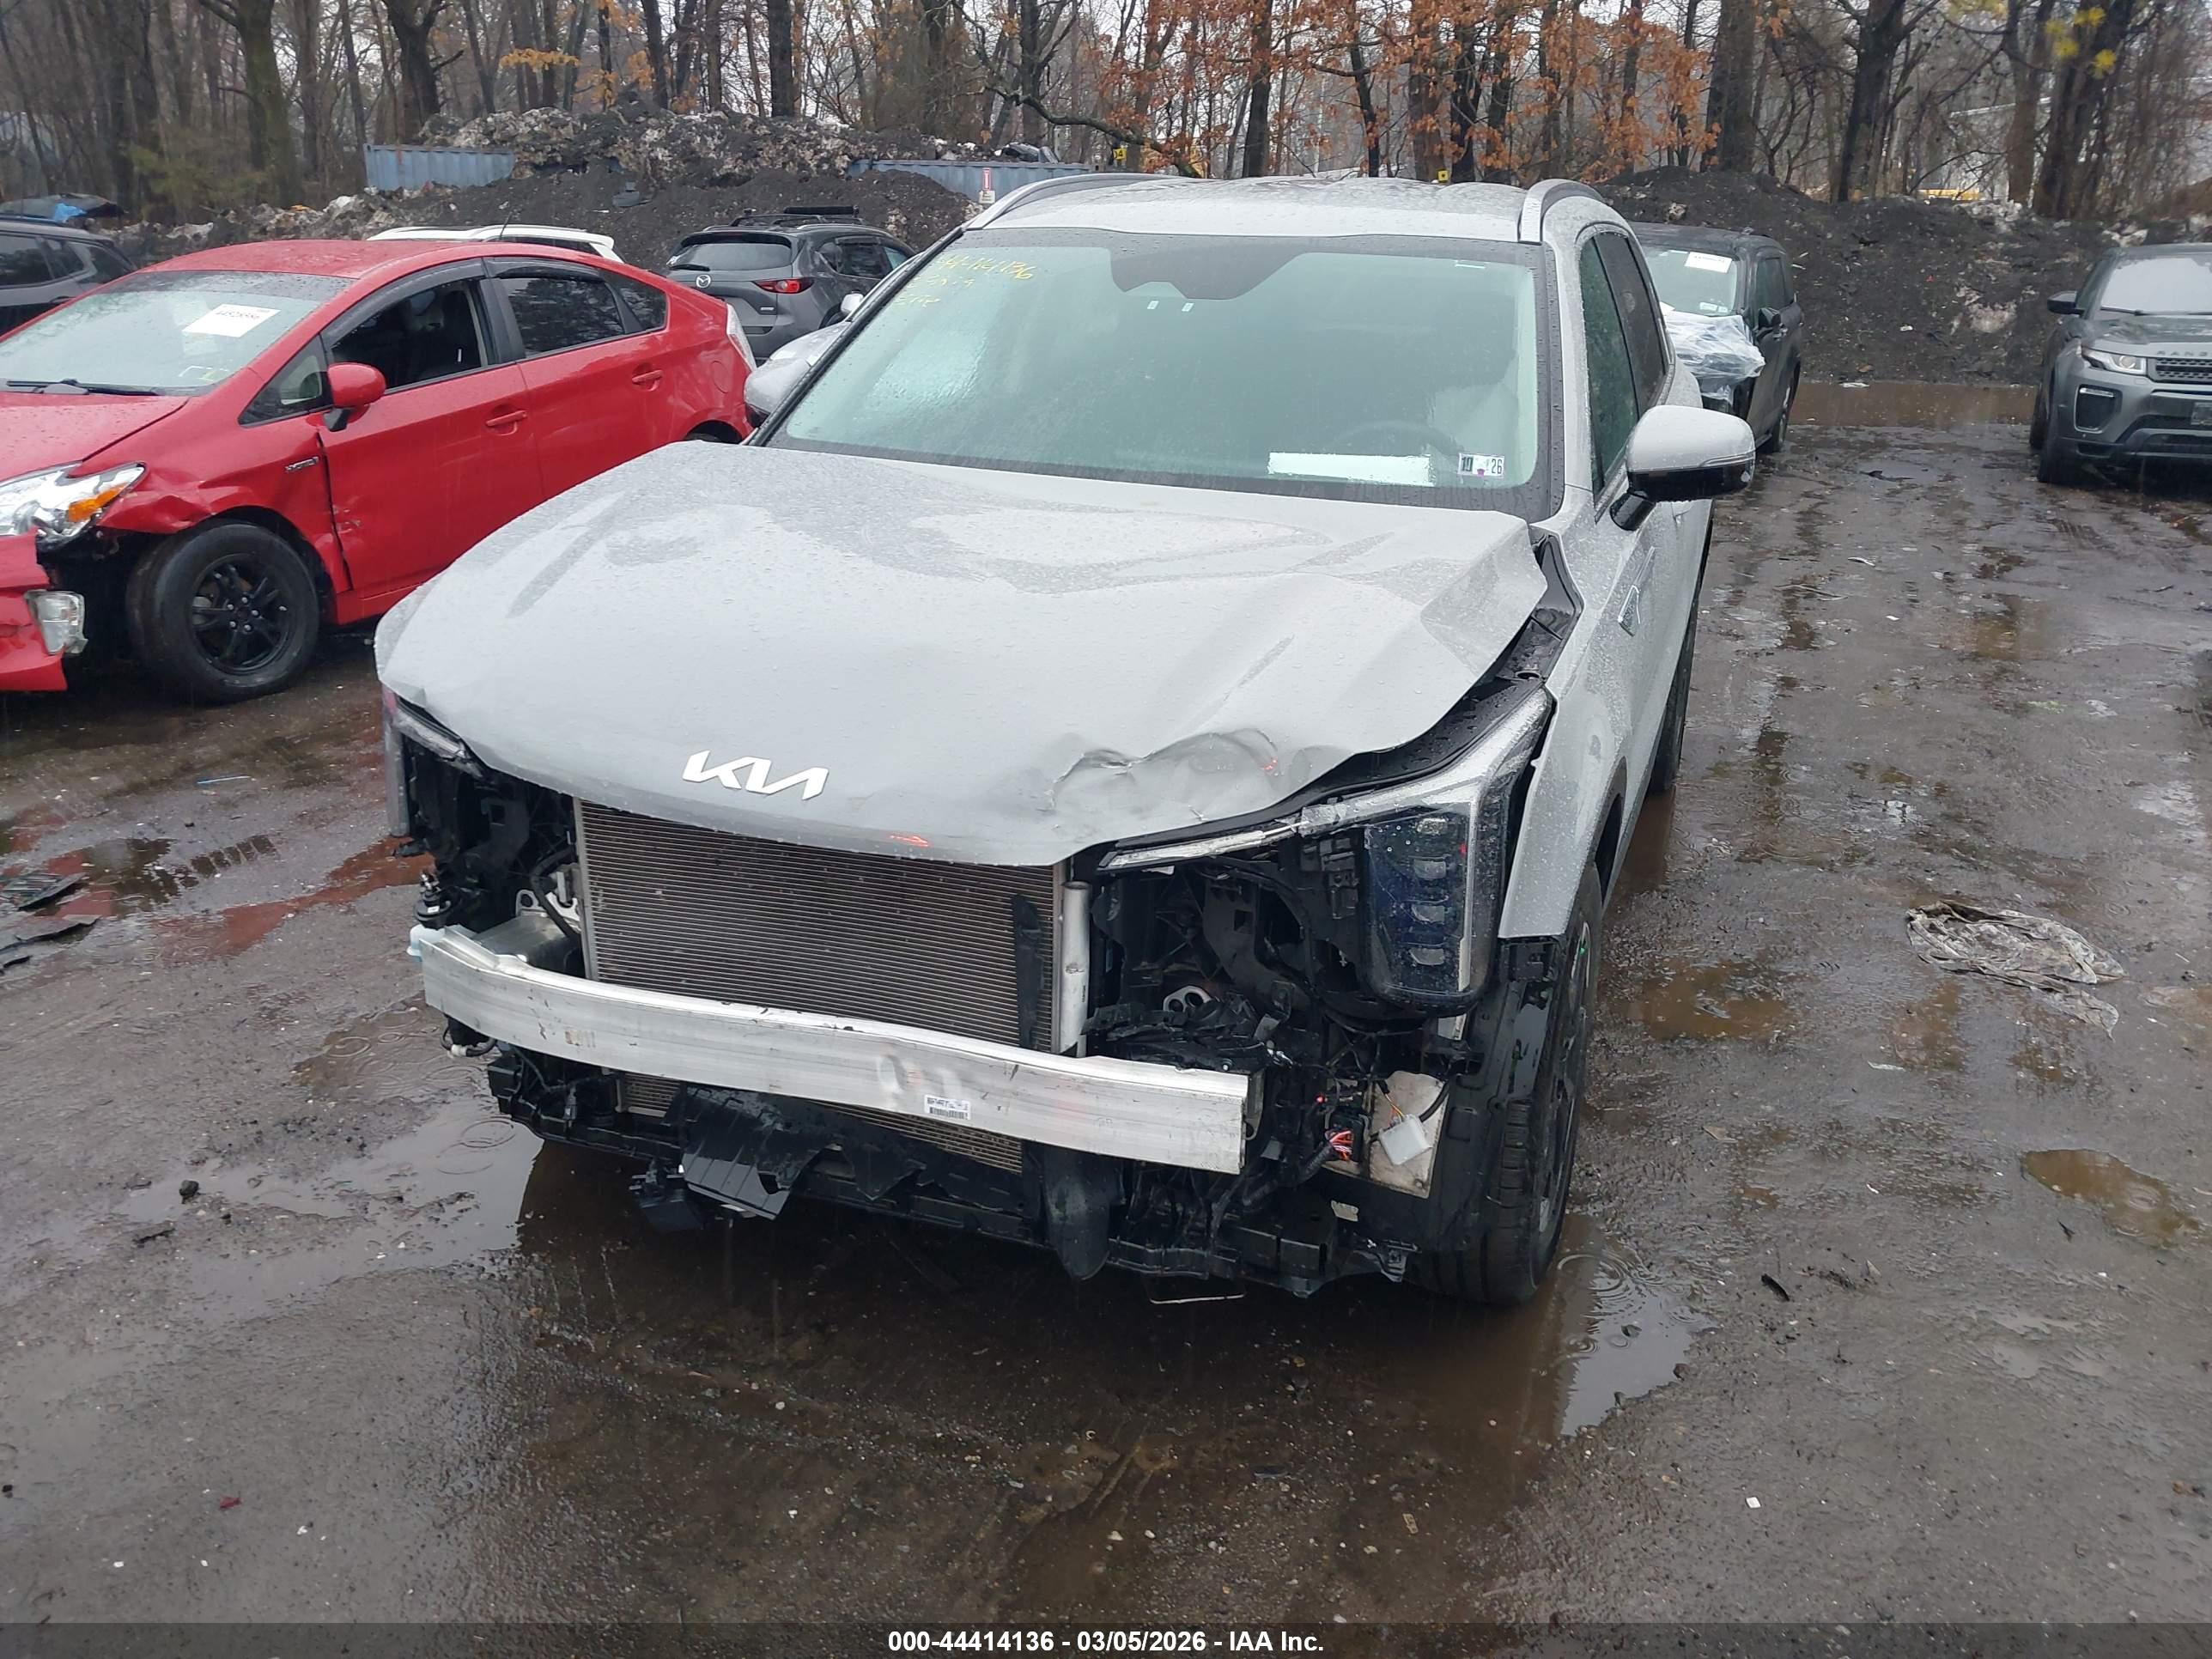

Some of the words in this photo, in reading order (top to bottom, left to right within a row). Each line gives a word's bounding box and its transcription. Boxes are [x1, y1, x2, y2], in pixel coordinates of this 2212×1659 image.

[1462, 456, 1474, 472] 10
[1491, 459, 1503, 474] 26
[682, 750, 830, 801] KIA
